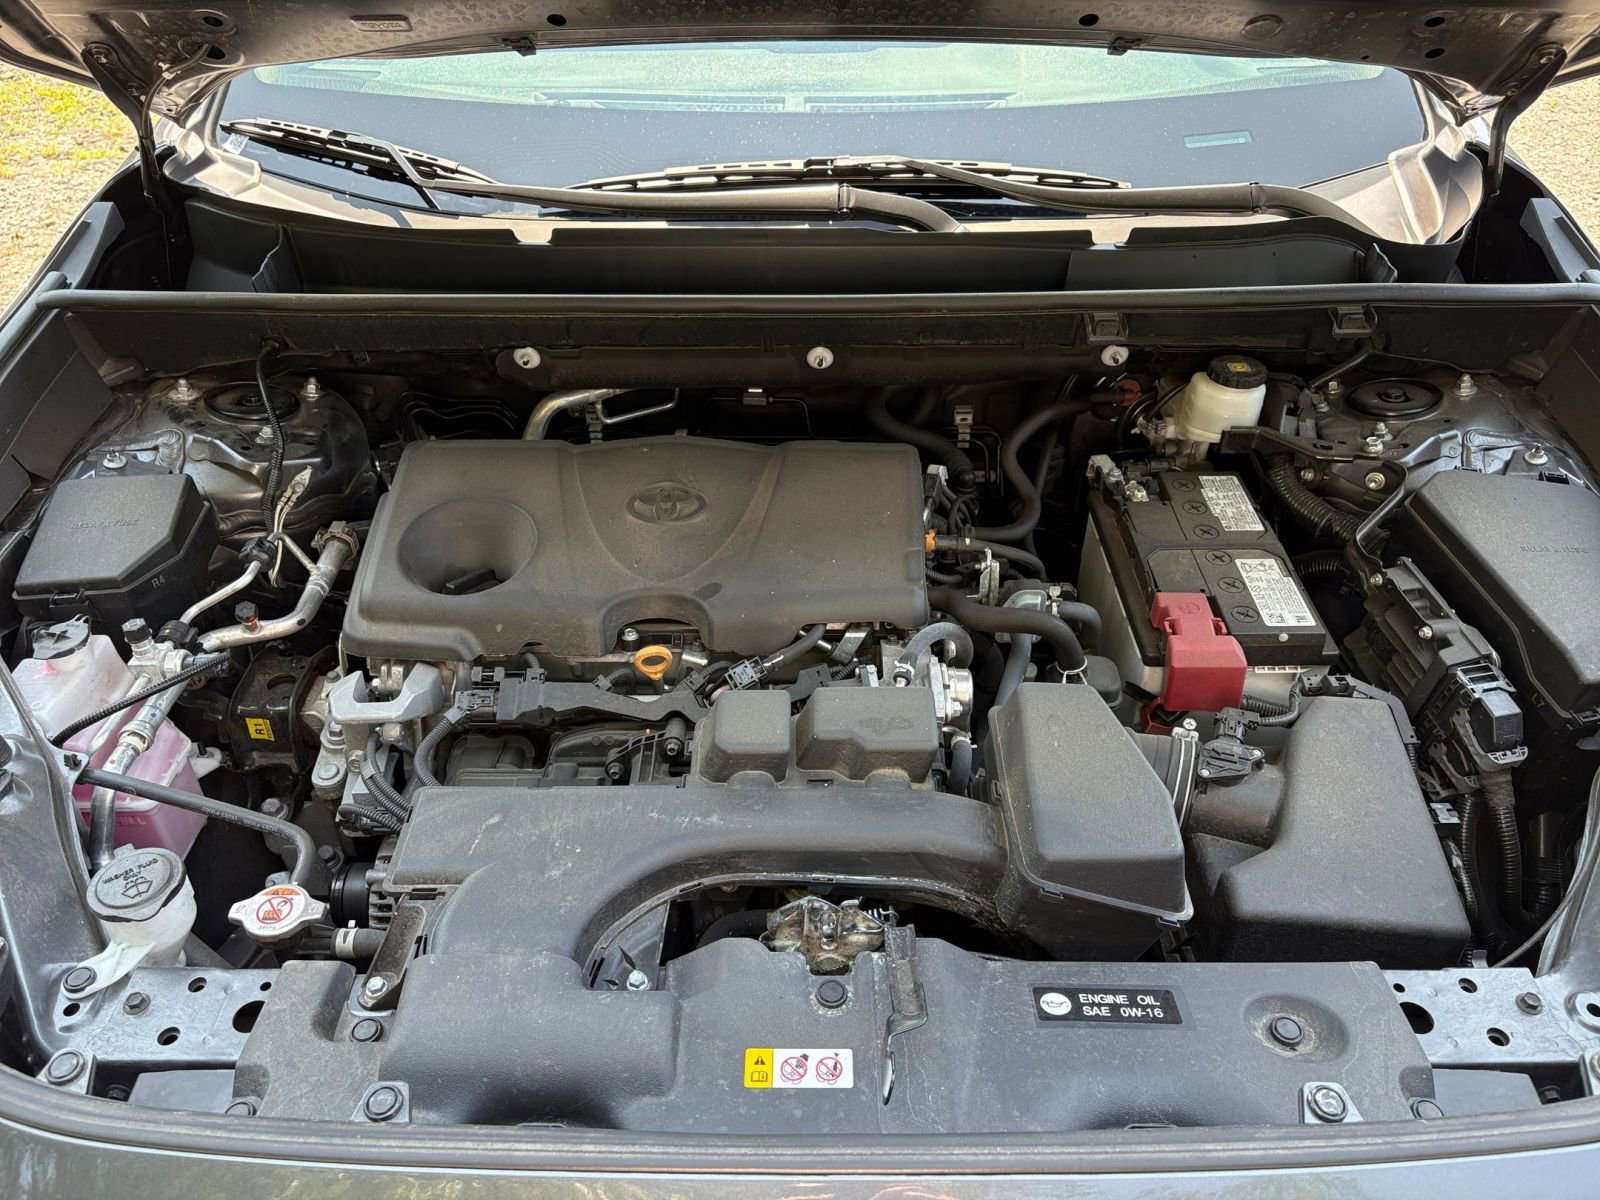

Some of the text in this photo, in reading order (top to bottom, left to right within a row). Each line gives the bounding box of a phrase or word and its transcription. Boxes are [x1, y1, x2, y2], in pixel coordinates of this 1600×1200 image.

[151, 574, 165, 589] R4
[1531, 693, 1545, 708] L7
[254, 723, 265, 735] R1
[102, 858, 158, 885] WASHER FLUID
[1078, 993, 1160, 1006] ENGINE OIL
[1083, 1006, 1164, 1018] SAE 0W-16
